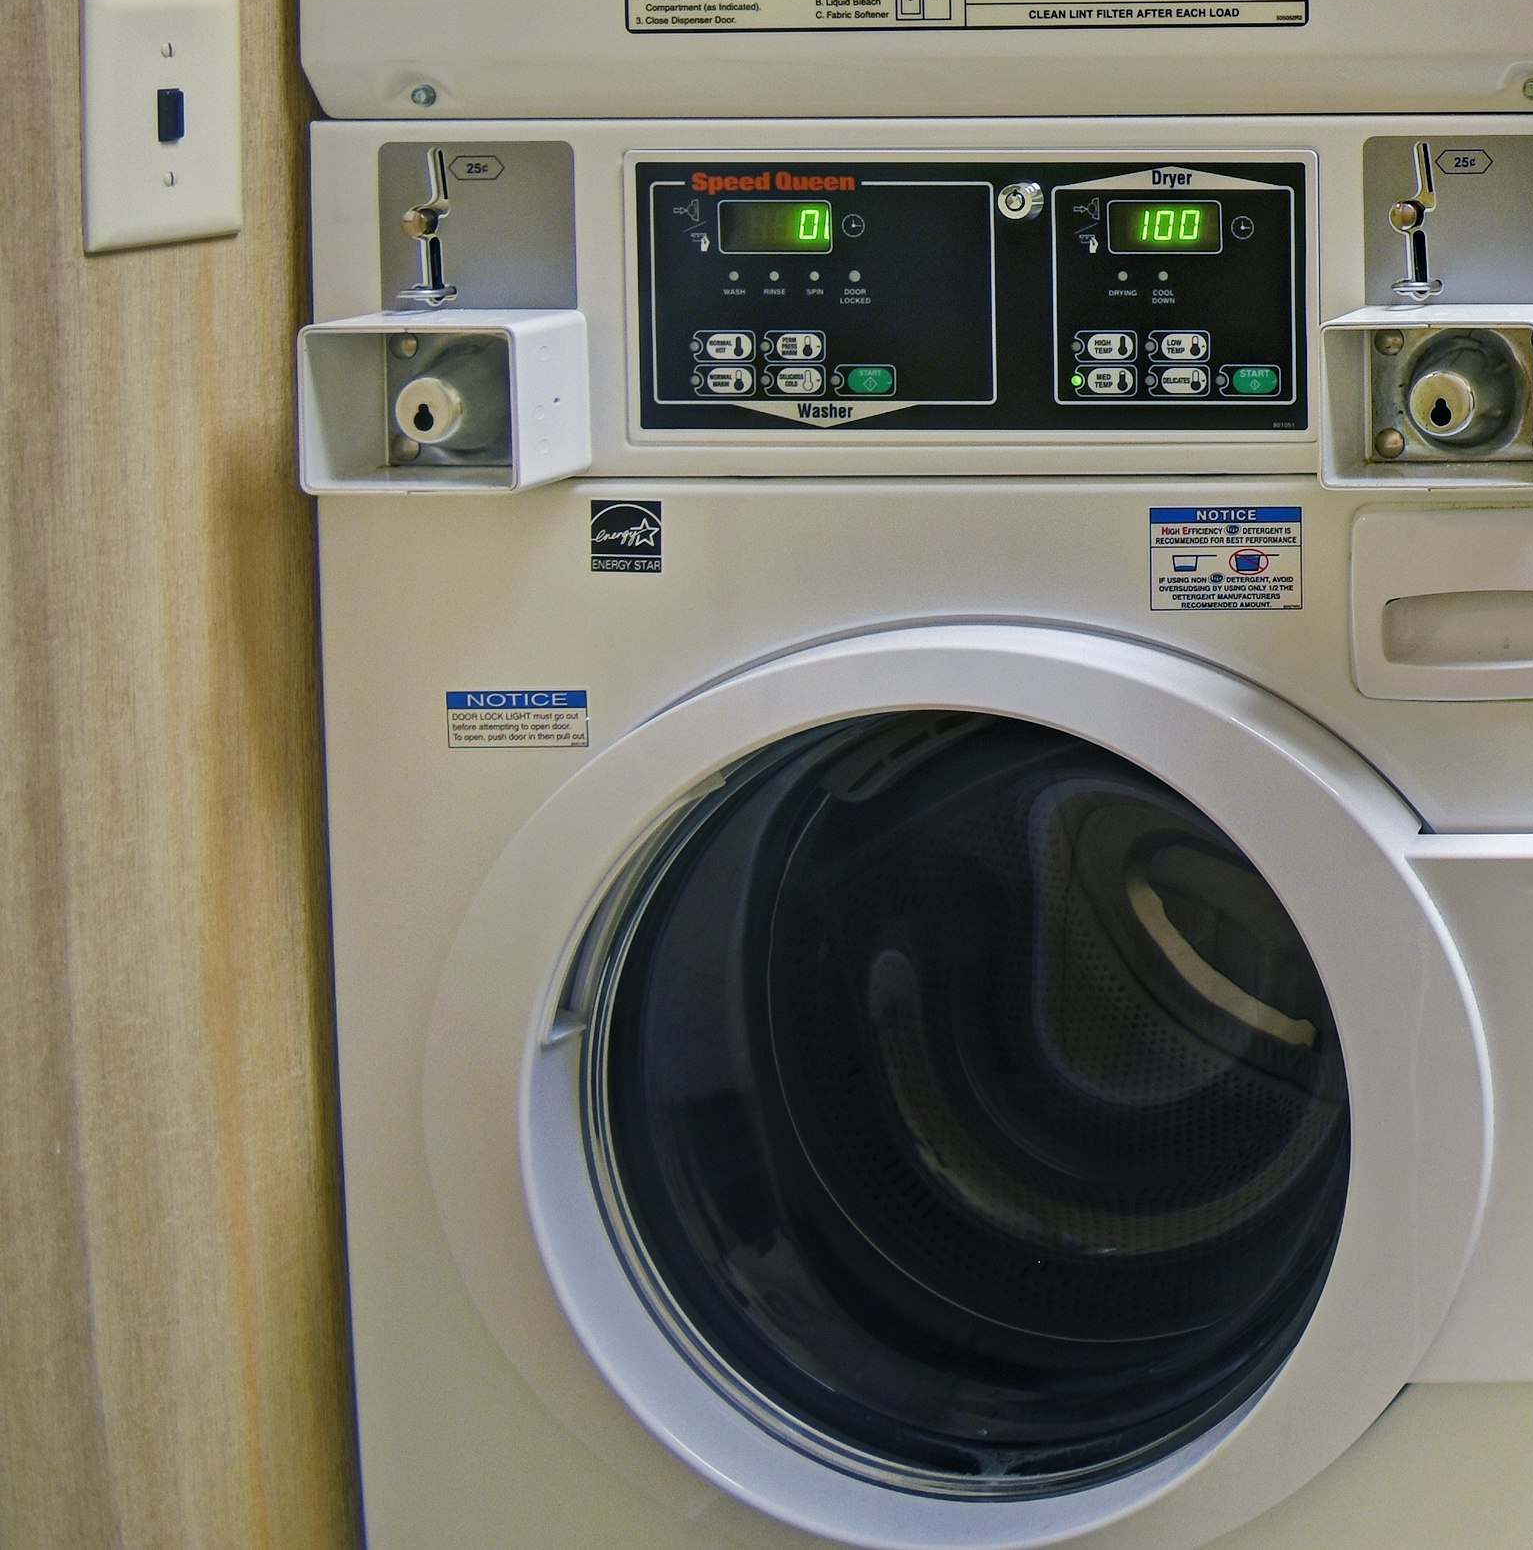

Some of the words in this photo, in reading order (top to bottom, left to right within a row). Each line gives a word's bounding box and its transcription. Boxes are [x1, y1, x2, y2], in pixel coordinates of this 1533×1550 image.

[644, 2, 702, 13] Compartment
[702, 2, 717, 12] (as
[717, 2, 761, 12] Indicated).
[1027, 9, 1066, 19] CLEAN
[1068, 9, 1094, 18] LINT
[1095, 8, 1133, 18] FILTER
[1135, 7, 1173, 18] AFTER
[1175, 7, 1206, 18] EACH
[1208, 7, 1240, 17] LOAD
[814, 10, 824, 19] C.
[825, 9, 852, 19] Fabric
[853, 9, 889, 19] Softener
[692, 172, 770, 195] Speed
[775, 171, 856, 191] Queen
[1152, 170, 1192, 188] Dryer
[1141, 209, 1201, 241] 100
[1108, 289, 1137, 297] DRYING
[1094, 339, 1112, 347] HIGH
[1166, 339, 1183, 347] LOW
[1094, 347, 1113, 355] TEMP
[1166, 347, 1185, 355] TEMP
[1239, 369, 1269, 378] START
[1094, 381, 1113, 389] TEMP
[797, 403, 853, 419] Washer
[1196, 509, 1257, 521] NOTICE
[591, 558, 632, 570] ENERGY
[633, 559, 661, 570] STAR
[467, 692, 568, 707] NOTICE
